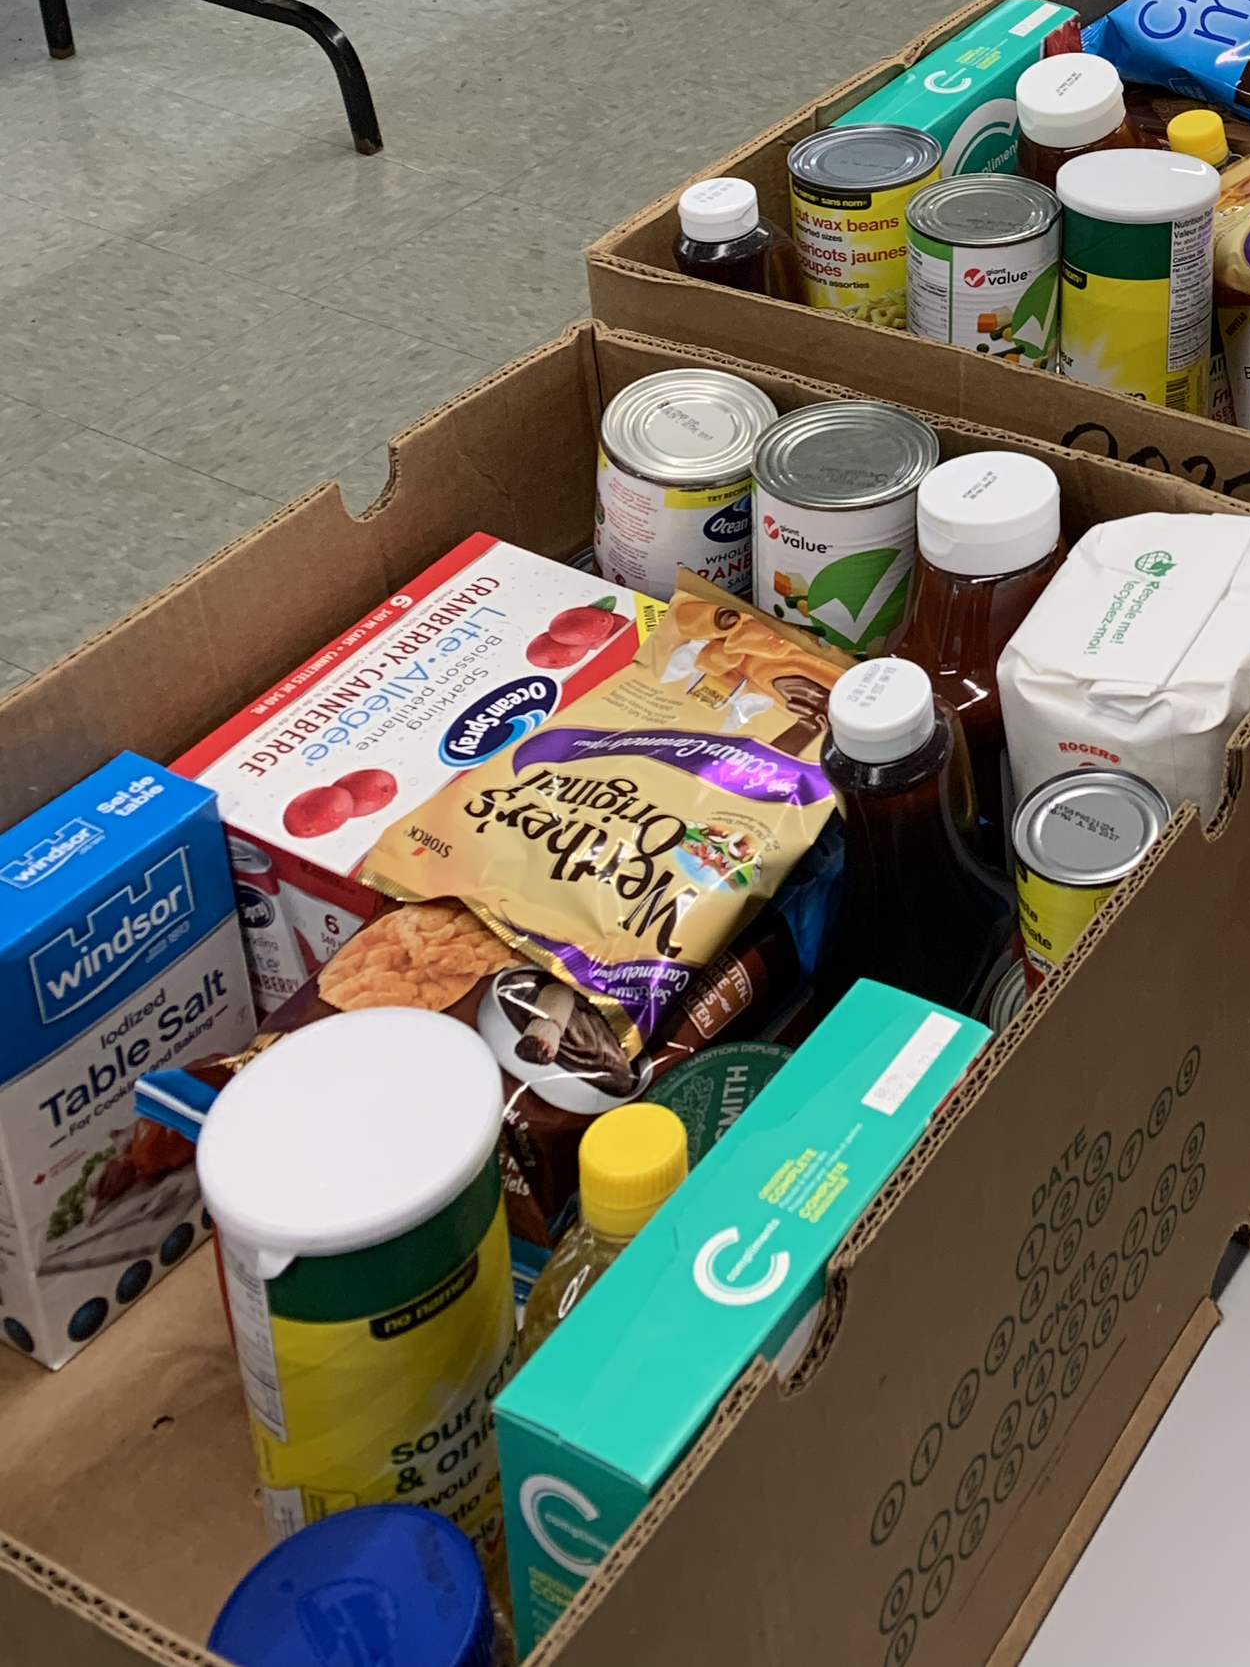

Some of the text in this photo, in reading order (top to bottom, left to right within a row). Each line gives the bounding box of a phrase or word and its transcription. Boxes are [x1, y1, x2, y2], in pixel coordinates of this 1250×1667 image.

[821, 196, 840, 207] sans
[811, 218, 842, 232] wax
[847, 215, 900, 233] beans
[822, 233, 843, 243] sizes
[1174, 214, 1204, 230] Nutrition
[1174, 227, 1196, 239] Valeur
[850, 245, 908, 266] jaunes
[986, 267, 1007, 277] giant
[828, 279, 870, 289] assorties
[988, 270, 1029, 286] value
[707, 493, 722, 503] TRY
[710, 516, 749, 534] Ocean
[780, 523, 800, 536] giant
[705, 544, 751, 566] WHOLE
[781, 535, 828, 554] value
[1112, 580, 1161, 646] Recycle me!
[289, 594, 414, 687] 6 CANNETTES
[238, 576, 500, 777] CRANBERRY CANNEBERGE
[355, 635, 503, 752] Boisson pétillante
[406, 668, 489, 731] Sparkling
[449, 682, 547, 755] Ocean Spray
[612, 736, 779, 791] Éclairs Caramels
[1058, 740, 1122, 765] ROGERS
[96, 775, 155, 815] Sel de
[115, 783, 165, 817] table
[518, 768, 690, 860] Original
[14, 826, 91, 883] windsor
[410, 824, 454, 860] STORCK
[463, 788, 700, 959] Werther's
[47, 885, 183, 1000] windsor
[324, 914, 340, 935] 6
[620, 961, 689, 990] Caramels
[101, 987, 167, 1051] Iodized
[39, 968, 229, 1129] Table Salt
[69, 1016, 214, 1137] For and Baking
[1030, 1125, 1089, 1218] DATE
[726, 1218, 781, 1282] compliments
[383, 1276, 466, 1334] no name
[1011, 1250, 1098, 1390] PACKER
[389, 1396, 477, 1467] sour
[395, 1464, 425, 1497] &
